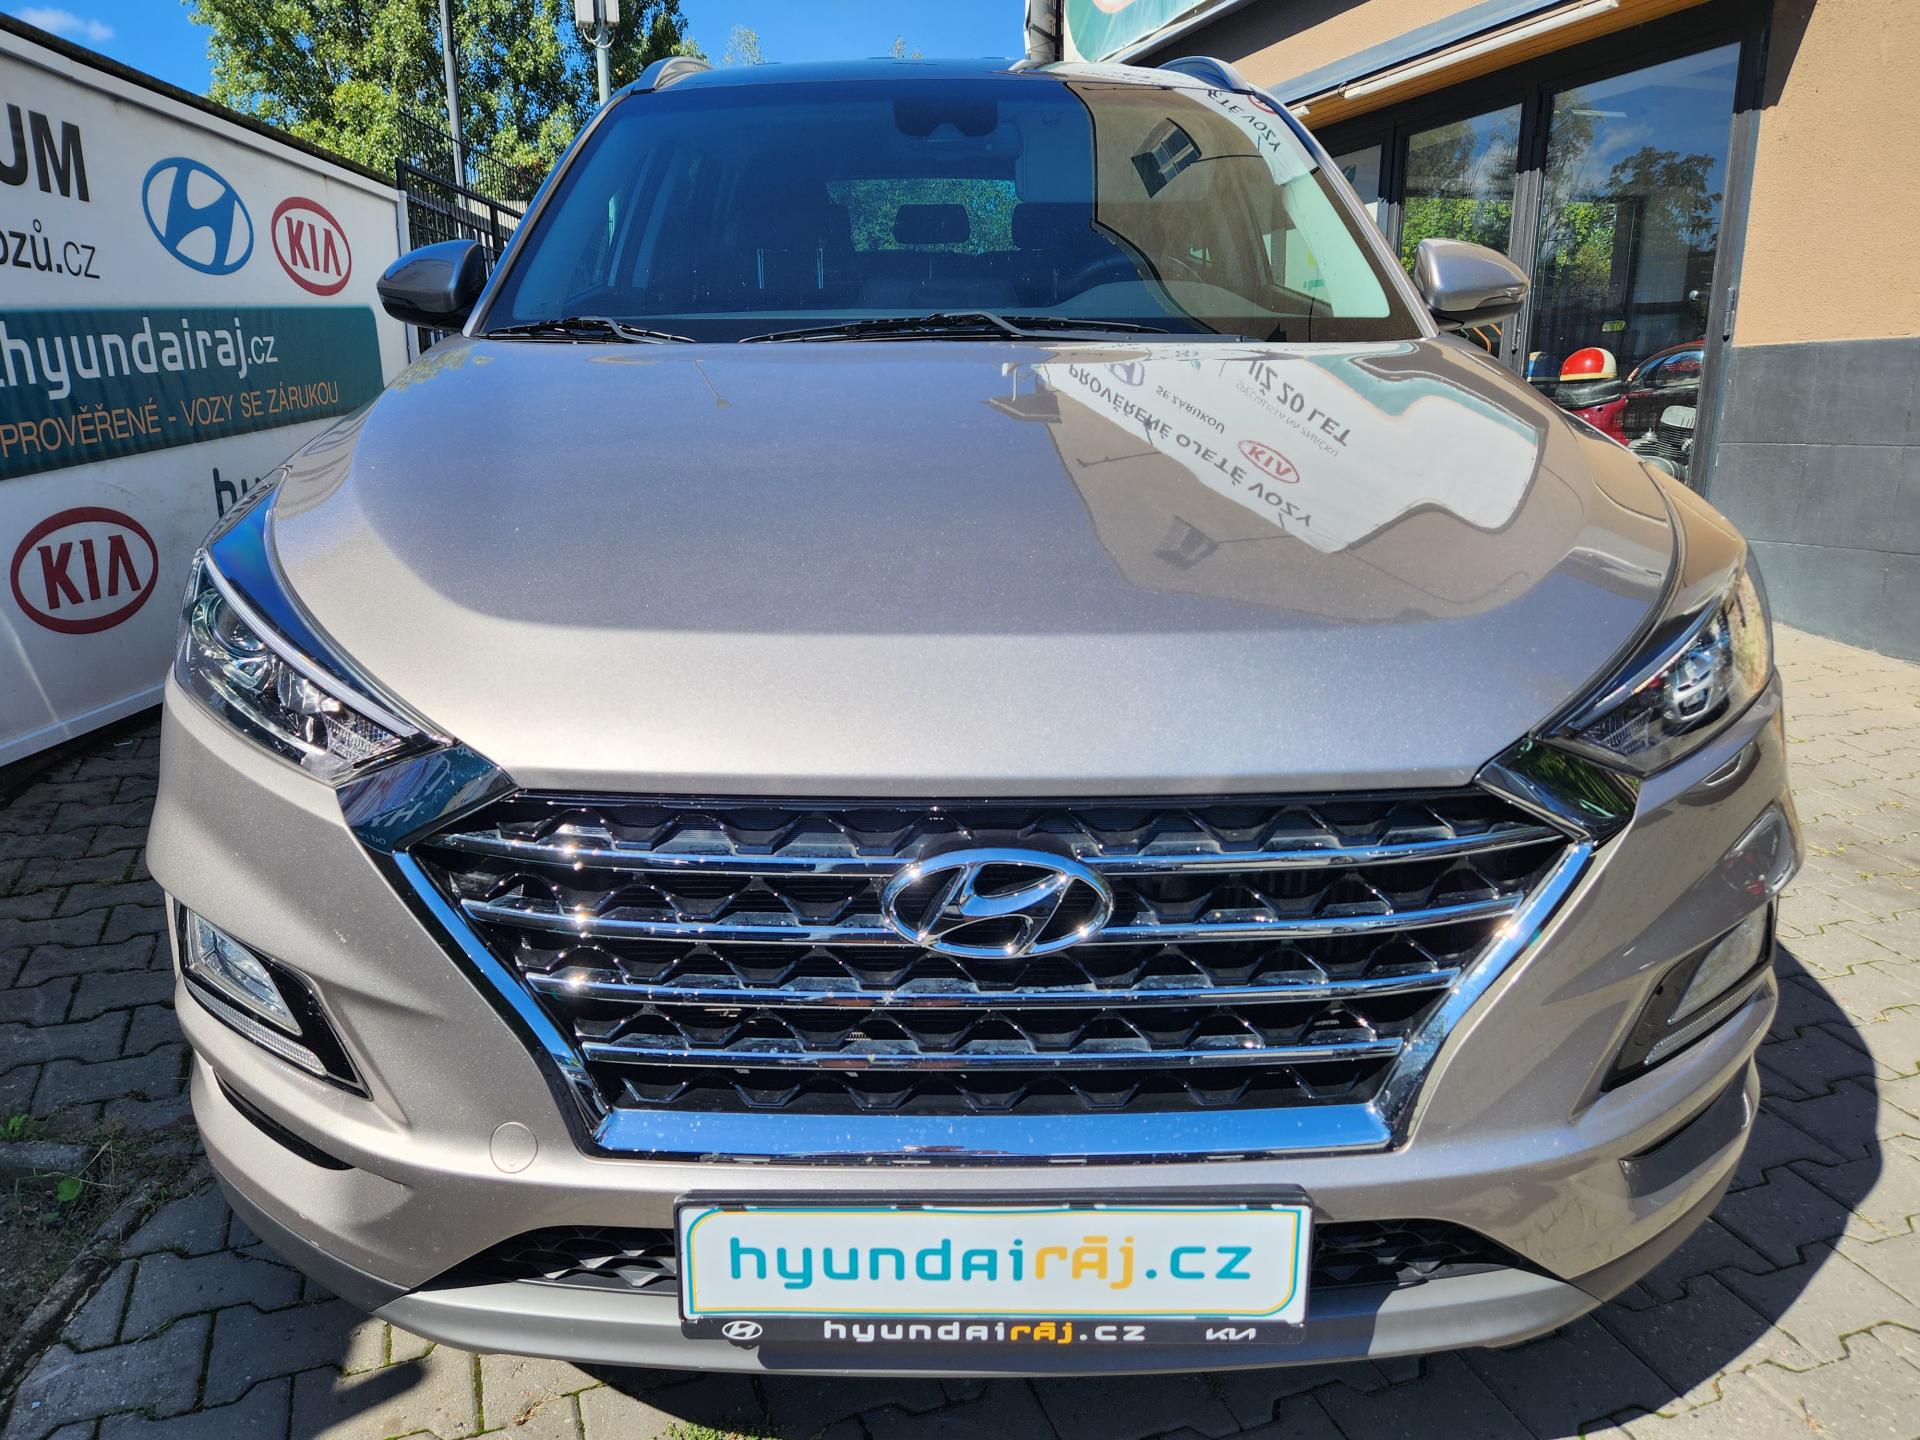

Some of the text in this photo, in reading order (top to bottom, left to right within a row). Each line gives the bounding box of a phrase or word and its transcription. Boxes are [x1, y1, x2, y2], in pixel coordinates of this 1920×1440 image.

[284, 215, 344, 278] KIA
[0, 397, 162, 458] PROVĚŘENÉ
[180, 394, 234, 427] VOZY
[239, 390, 265, 418] SE
[266, 381, 340, 414] ZÁRUKOU
[37, 534, 142, 610] KIA
